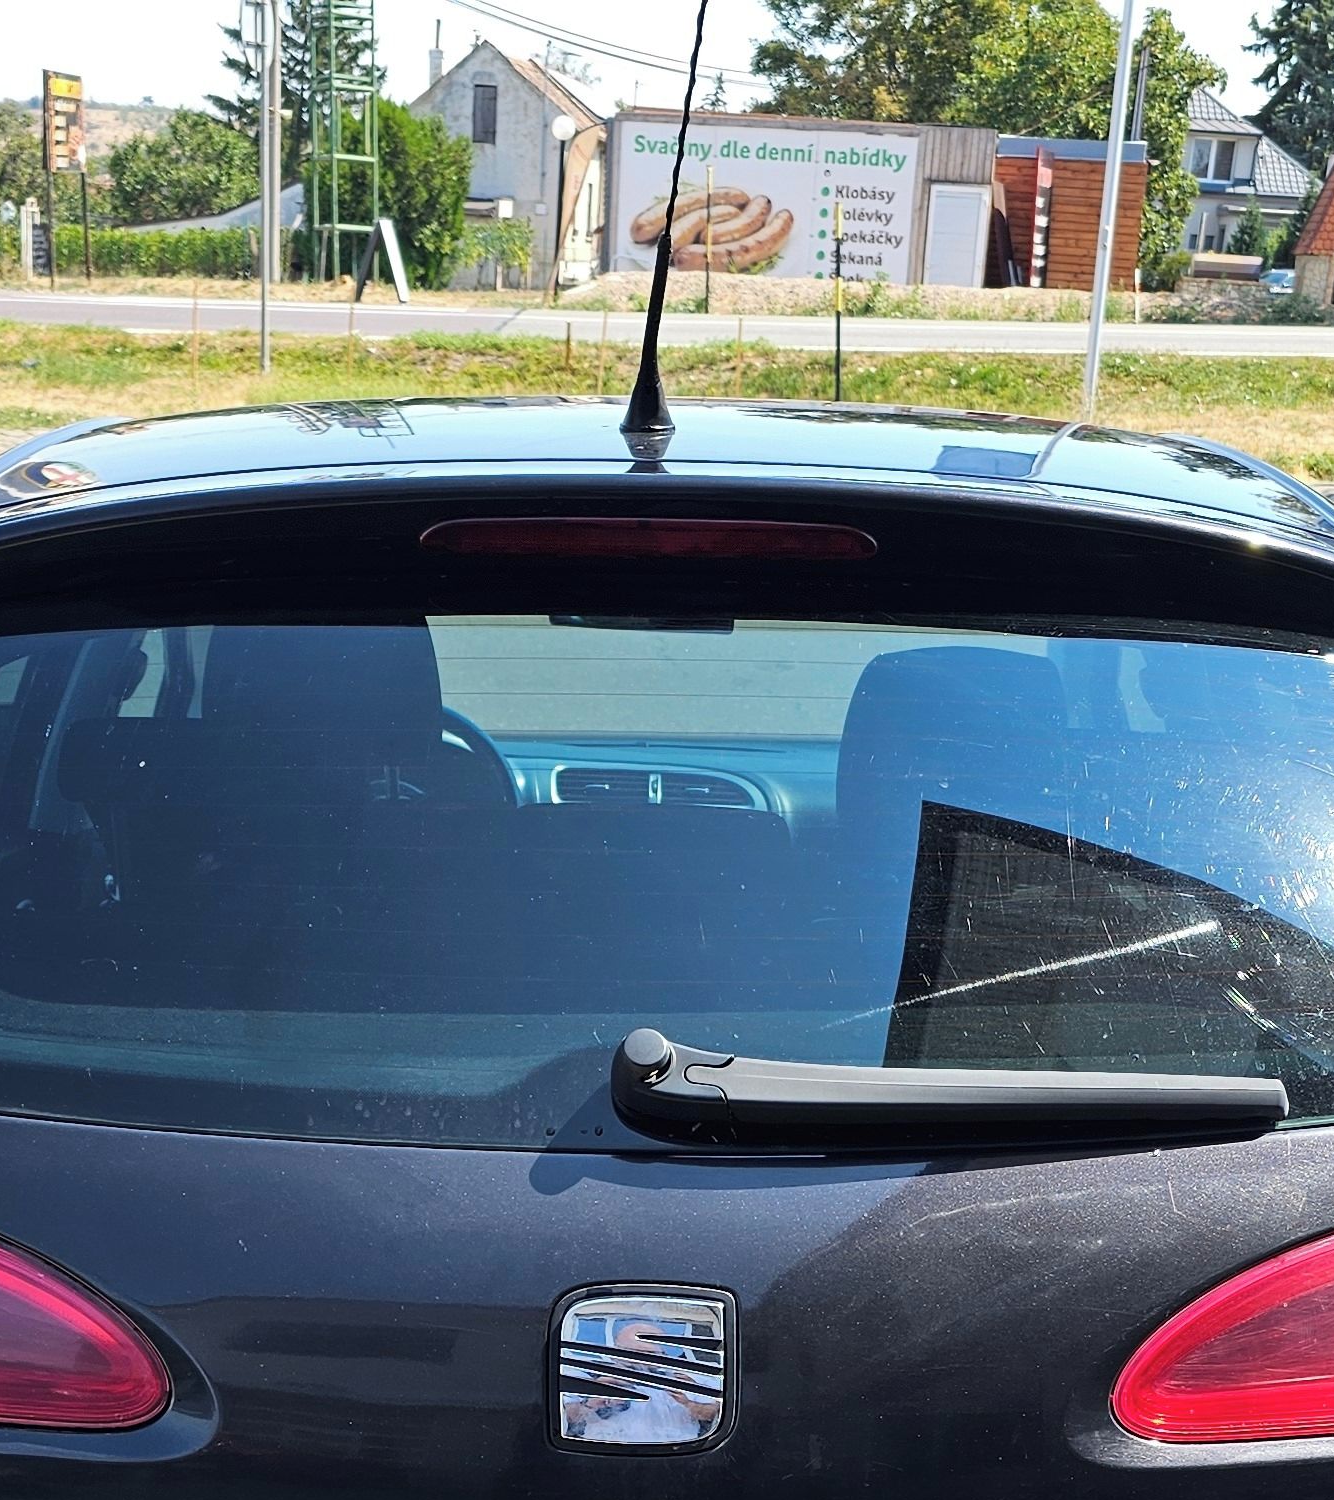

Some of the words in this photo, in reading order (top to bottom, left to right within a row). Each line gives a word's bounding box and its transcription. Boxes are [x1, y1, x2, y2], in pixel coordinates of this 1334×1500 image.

[634, 135, 712, 162] Svačny
[720, 141, 751, 159] dle
[755, 142, 814, 163] denní
[824, 147, 907, 173] nabídky
[835, 185, 895, 204] Klobásy
[834, 207, 893, 226] olévky
[830, 250, 883, 266] Sekaná
